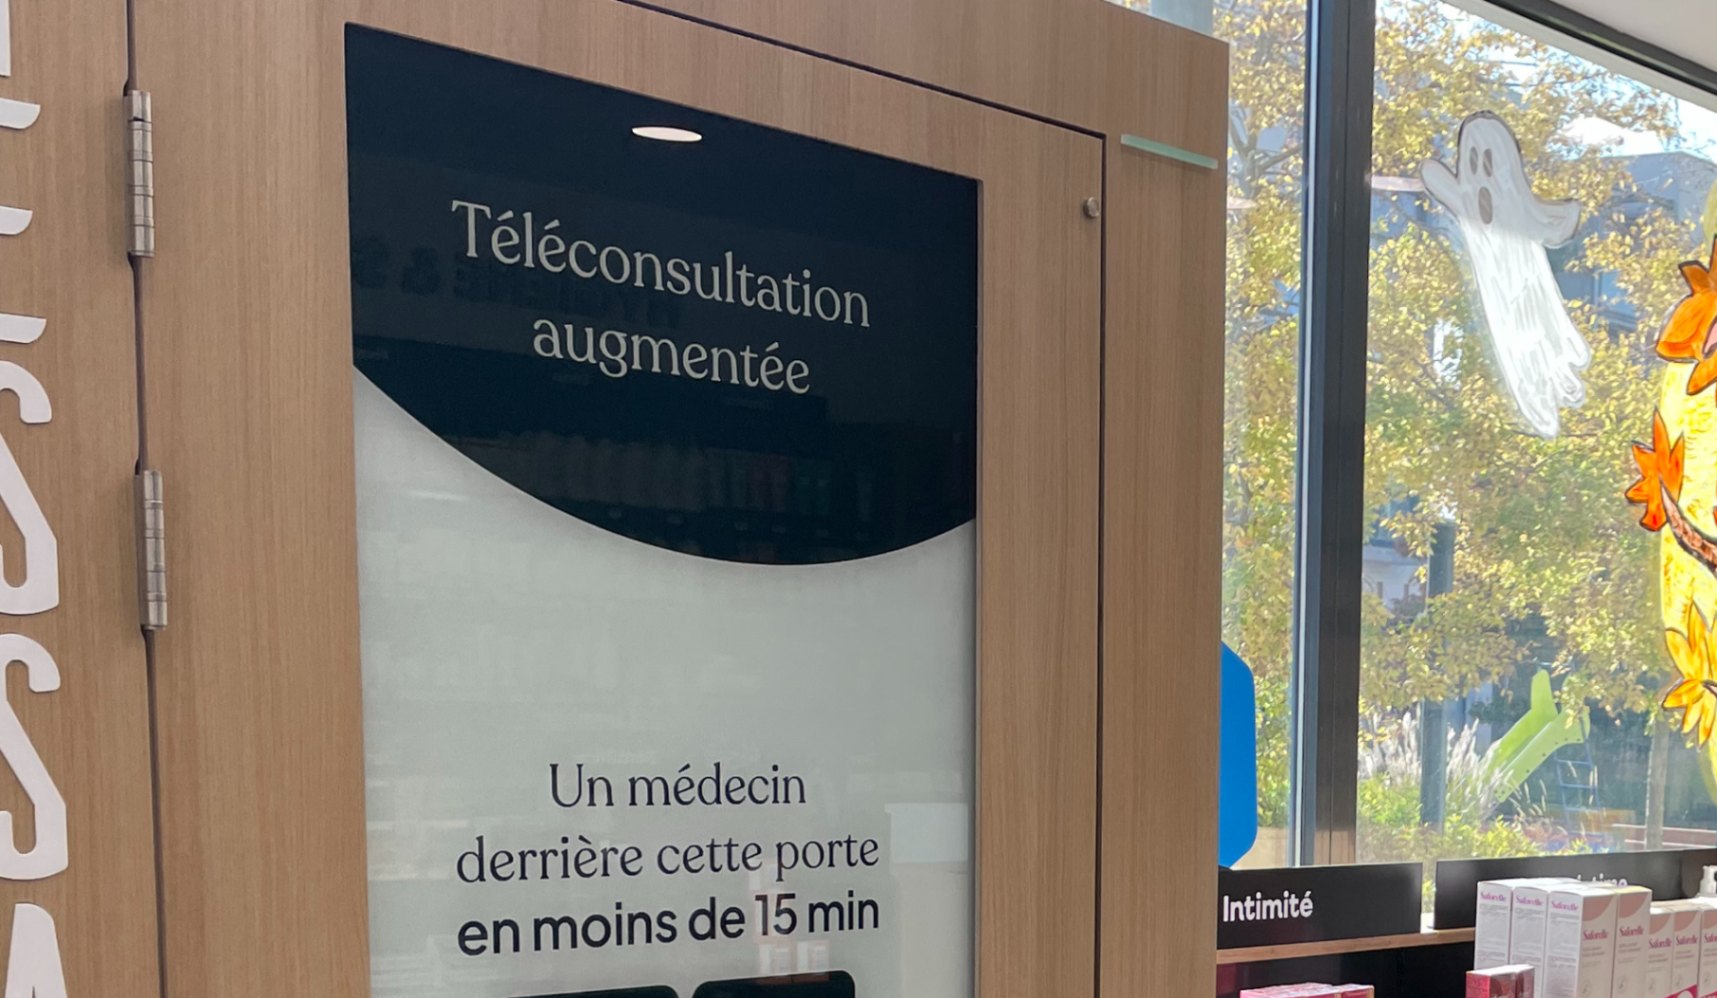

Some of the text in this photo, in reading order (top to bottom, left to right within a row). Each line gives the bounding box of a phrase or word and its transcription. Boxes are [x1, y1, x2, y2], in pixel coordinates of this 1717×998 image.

[452, 199, 870, 328] Téléconsultation
[532, 317, 811, 395] augmentée
[549, 761, 806, 807] Un médecin
[456, 835, 879, 882] derrière cette porte
[457, 890, 880, 956] en moins de 15 min
[1222, 889, 1313, 923] Intimité
